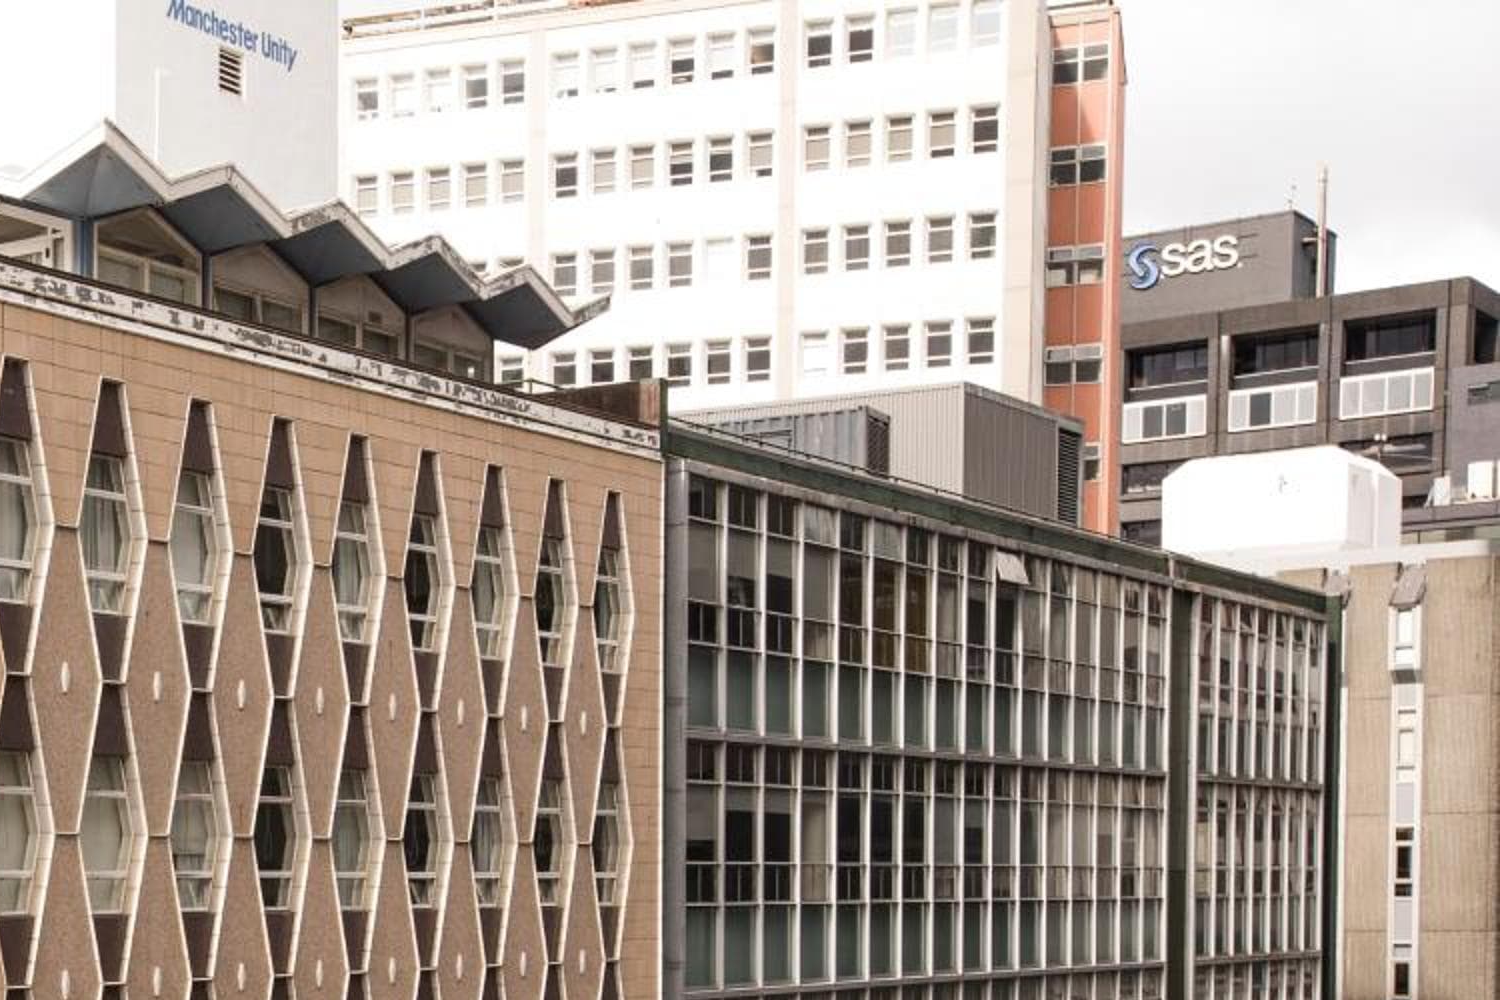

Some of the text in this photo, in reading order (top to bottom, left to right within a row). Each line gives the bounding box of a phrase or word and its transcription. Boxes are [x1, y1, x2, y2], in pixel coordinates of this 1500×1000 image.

[167, 0, 298, 73] Manchester Unity
[1160, 233, 1240, 276] sas
